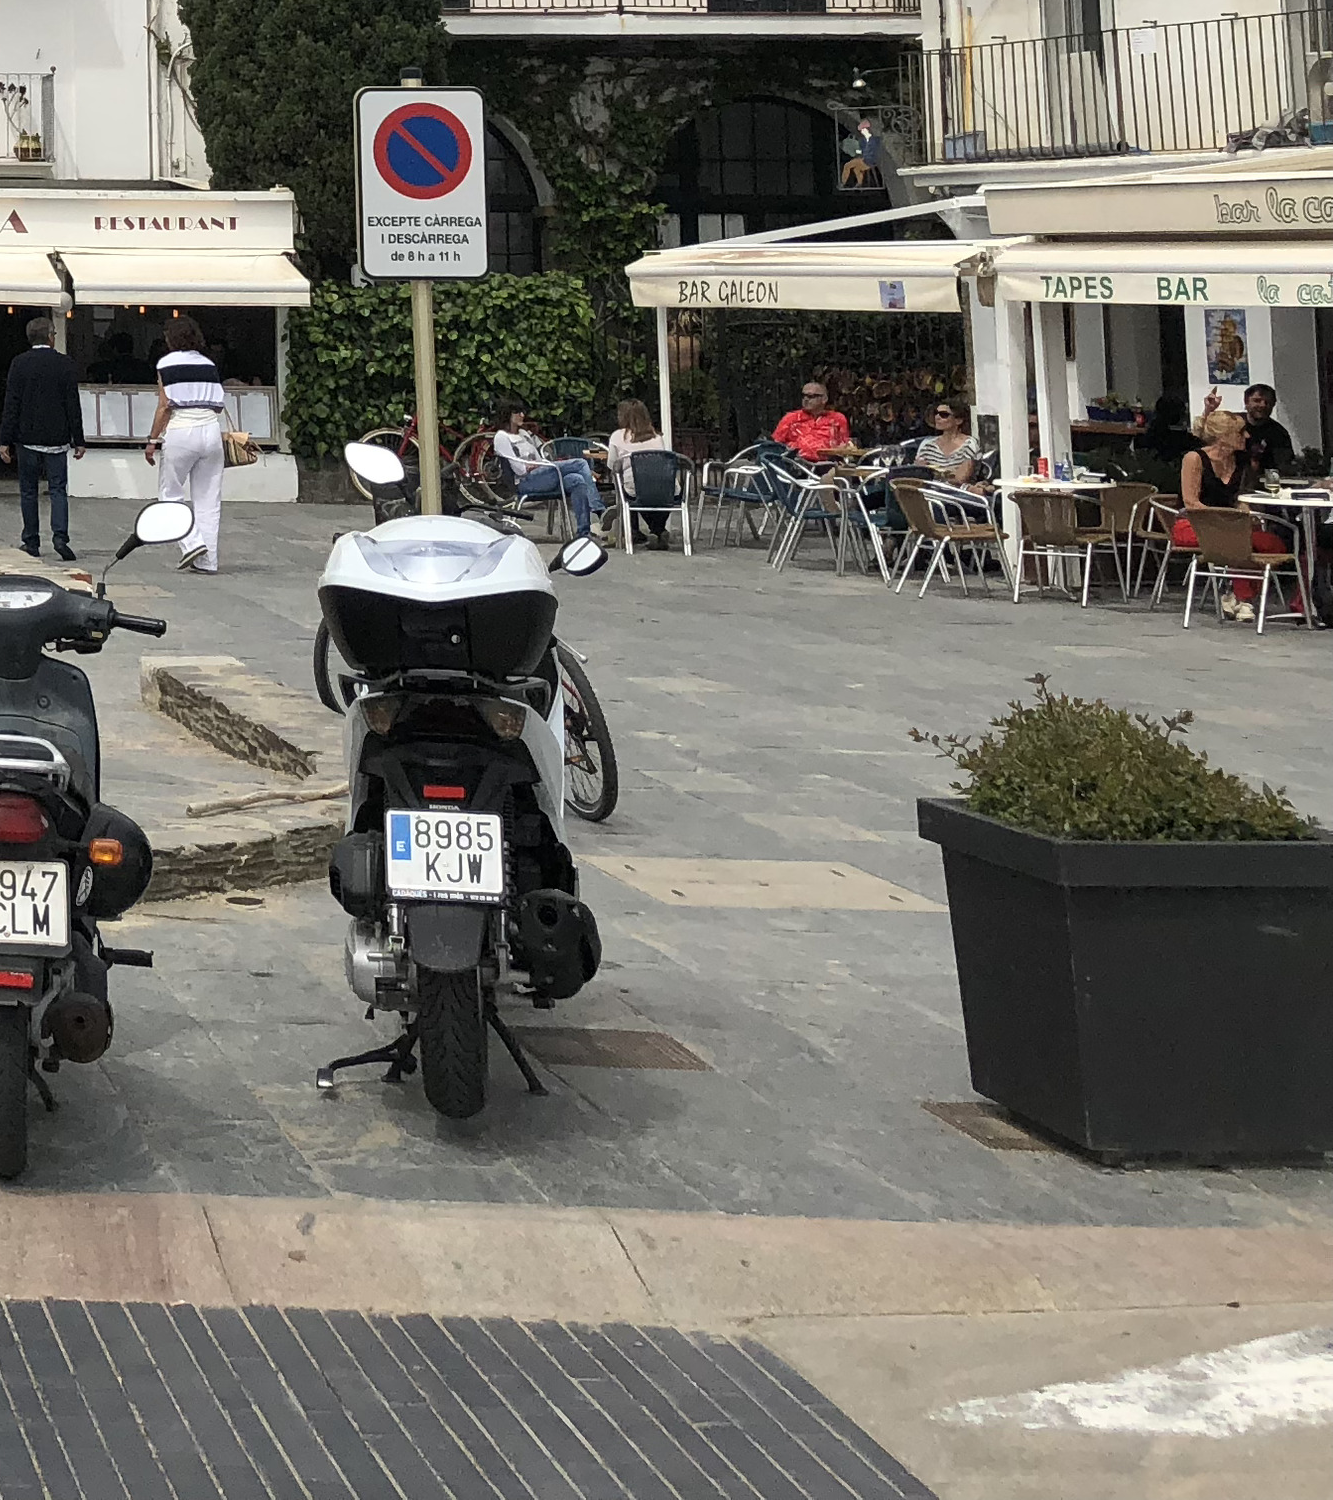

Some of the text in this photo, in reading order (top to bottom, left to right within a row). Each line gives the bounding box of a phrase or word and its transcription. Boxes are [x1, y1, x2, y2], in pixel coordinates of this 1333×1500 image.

[1213, 194, 1261, 224] bar
[1265, 186, 1299, 224] la
[94, 216, 240, 231] RESTAURANT
[367, 214, 483, 227] EXCEPTE CÀRREGA
[381, 231, 470, 244] I DESCÀRREGA
[391, 251, 461, 262] de 8 h a 11 h
[678, 280, 779, 304] BAR GALEON
[1040, 275, 1114, 299] TAPES
[1156, 277, 1208, 300] BAR
[1256, 275, 1280, 304] la
[396, 841, 406, 852] E
[415, 819, 493, 851] 8985
[425, 852, 483, 884] KJW
